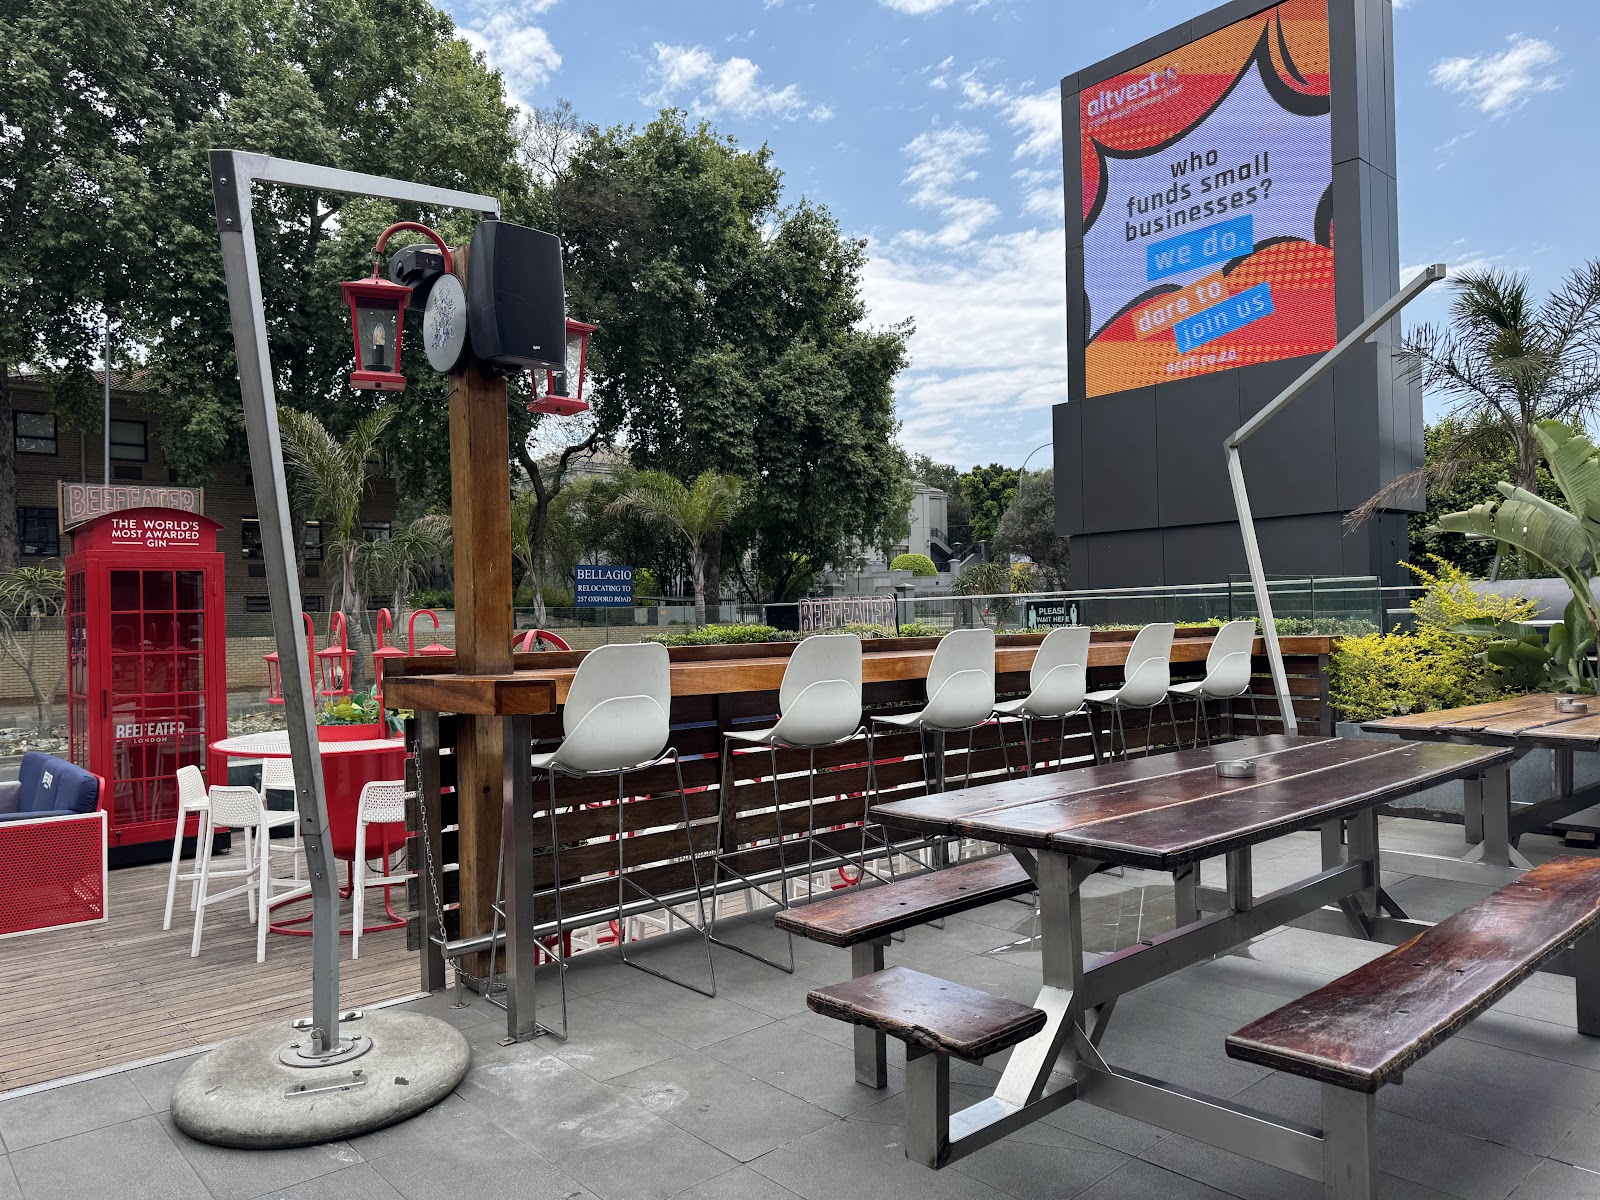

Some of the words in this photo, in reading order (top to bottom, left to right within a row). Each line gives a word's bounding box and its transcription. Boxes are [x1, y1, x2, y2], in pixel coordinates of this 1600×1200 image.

[1088, 72, 1158, 117] altvest
[1170, 149, 1218, 178] who
[1126, 182, 1192, 218] funds
[1200, 151, 1269, 194] small
[1125, 178, 1272, 242] businesses?
[1154, 245, 1191, 270] we
[1202, 229, 1246, 257] do.
[1138, 297, 1189, 332] dare
[1195, 281, 1222, 304] to
[1183, 312, 1229, 350] join
[1236, 293, 1265, 319] us
[69, 485, 195, 519] BEEFEATER
[111, 529, 143, 538] MOST
[145, 530, 199, 540] AWARDED
[112, 518, 136, 529] THE
[143, 519, 199, 530] WORLD'S
[147, 539, 167, 548] GIN
[577, 569, 632, 580] BELLAGIO
[577, 584, 621, 592] RELOCATING
[577, 595, 588, 603] 257
[588, 595, 613, 603] OXFORD
[799, 594, 897, 637] BEEFEATER
